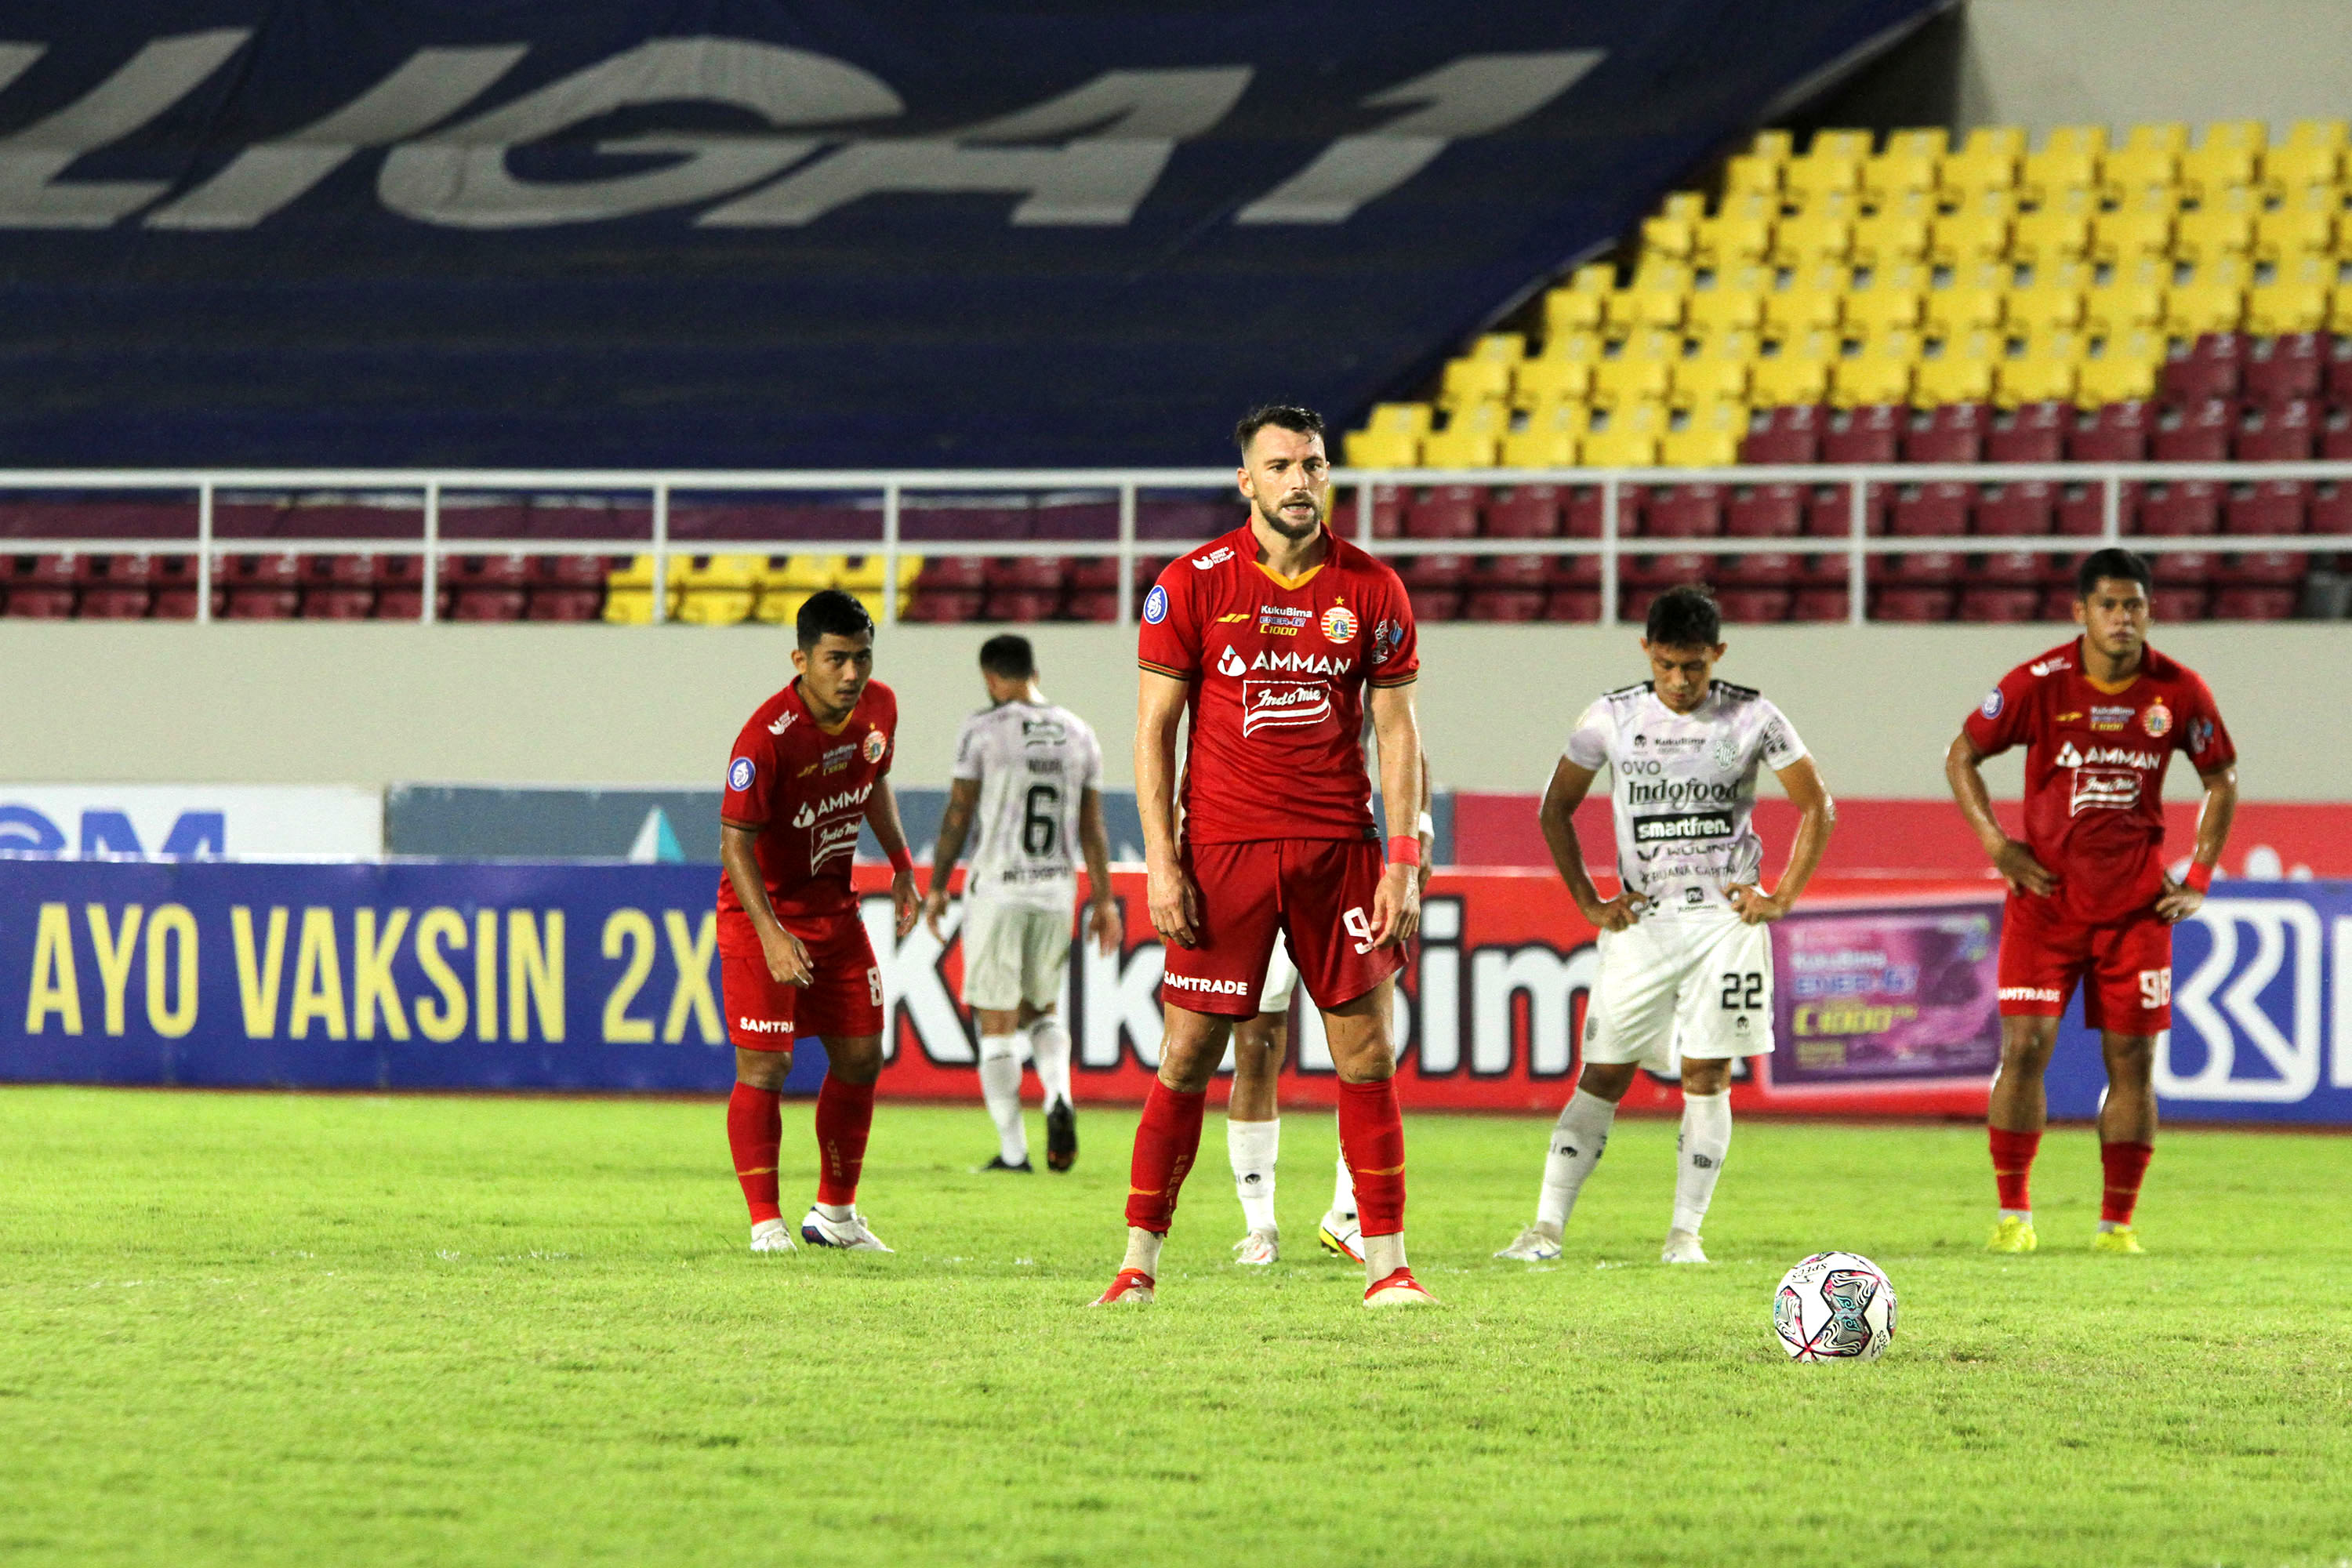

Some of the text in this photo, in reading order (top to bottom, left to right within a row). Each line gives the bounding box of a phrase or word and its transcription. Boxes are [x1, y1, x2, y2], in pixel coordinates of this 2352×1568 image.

[0, 27, 1607, 231] LIGA 1
[1261, 605, 1313, 618] KukuBima
[1260, 623, 1298, 636] C1000
[1250, 650, 1351, 676] AMMAN
[1622, 760, 1661, 775] OVO
[2084, 746, 2161, 770] AMMAN
[1628, 777, 1740, 810] Indofood
[1024, 786, 1058, 856] 6
[1343, 907, 1374, 954] 9
[26, 903, 725, 1046] AYO VAKSIN 2X
[867, 967, 884, 1007] 8
[1163, 970, 1248, 996] SAMTRADE
[1722, 972, 1762, 1010] 22
[2138, 967, 2172, 1010] 98
